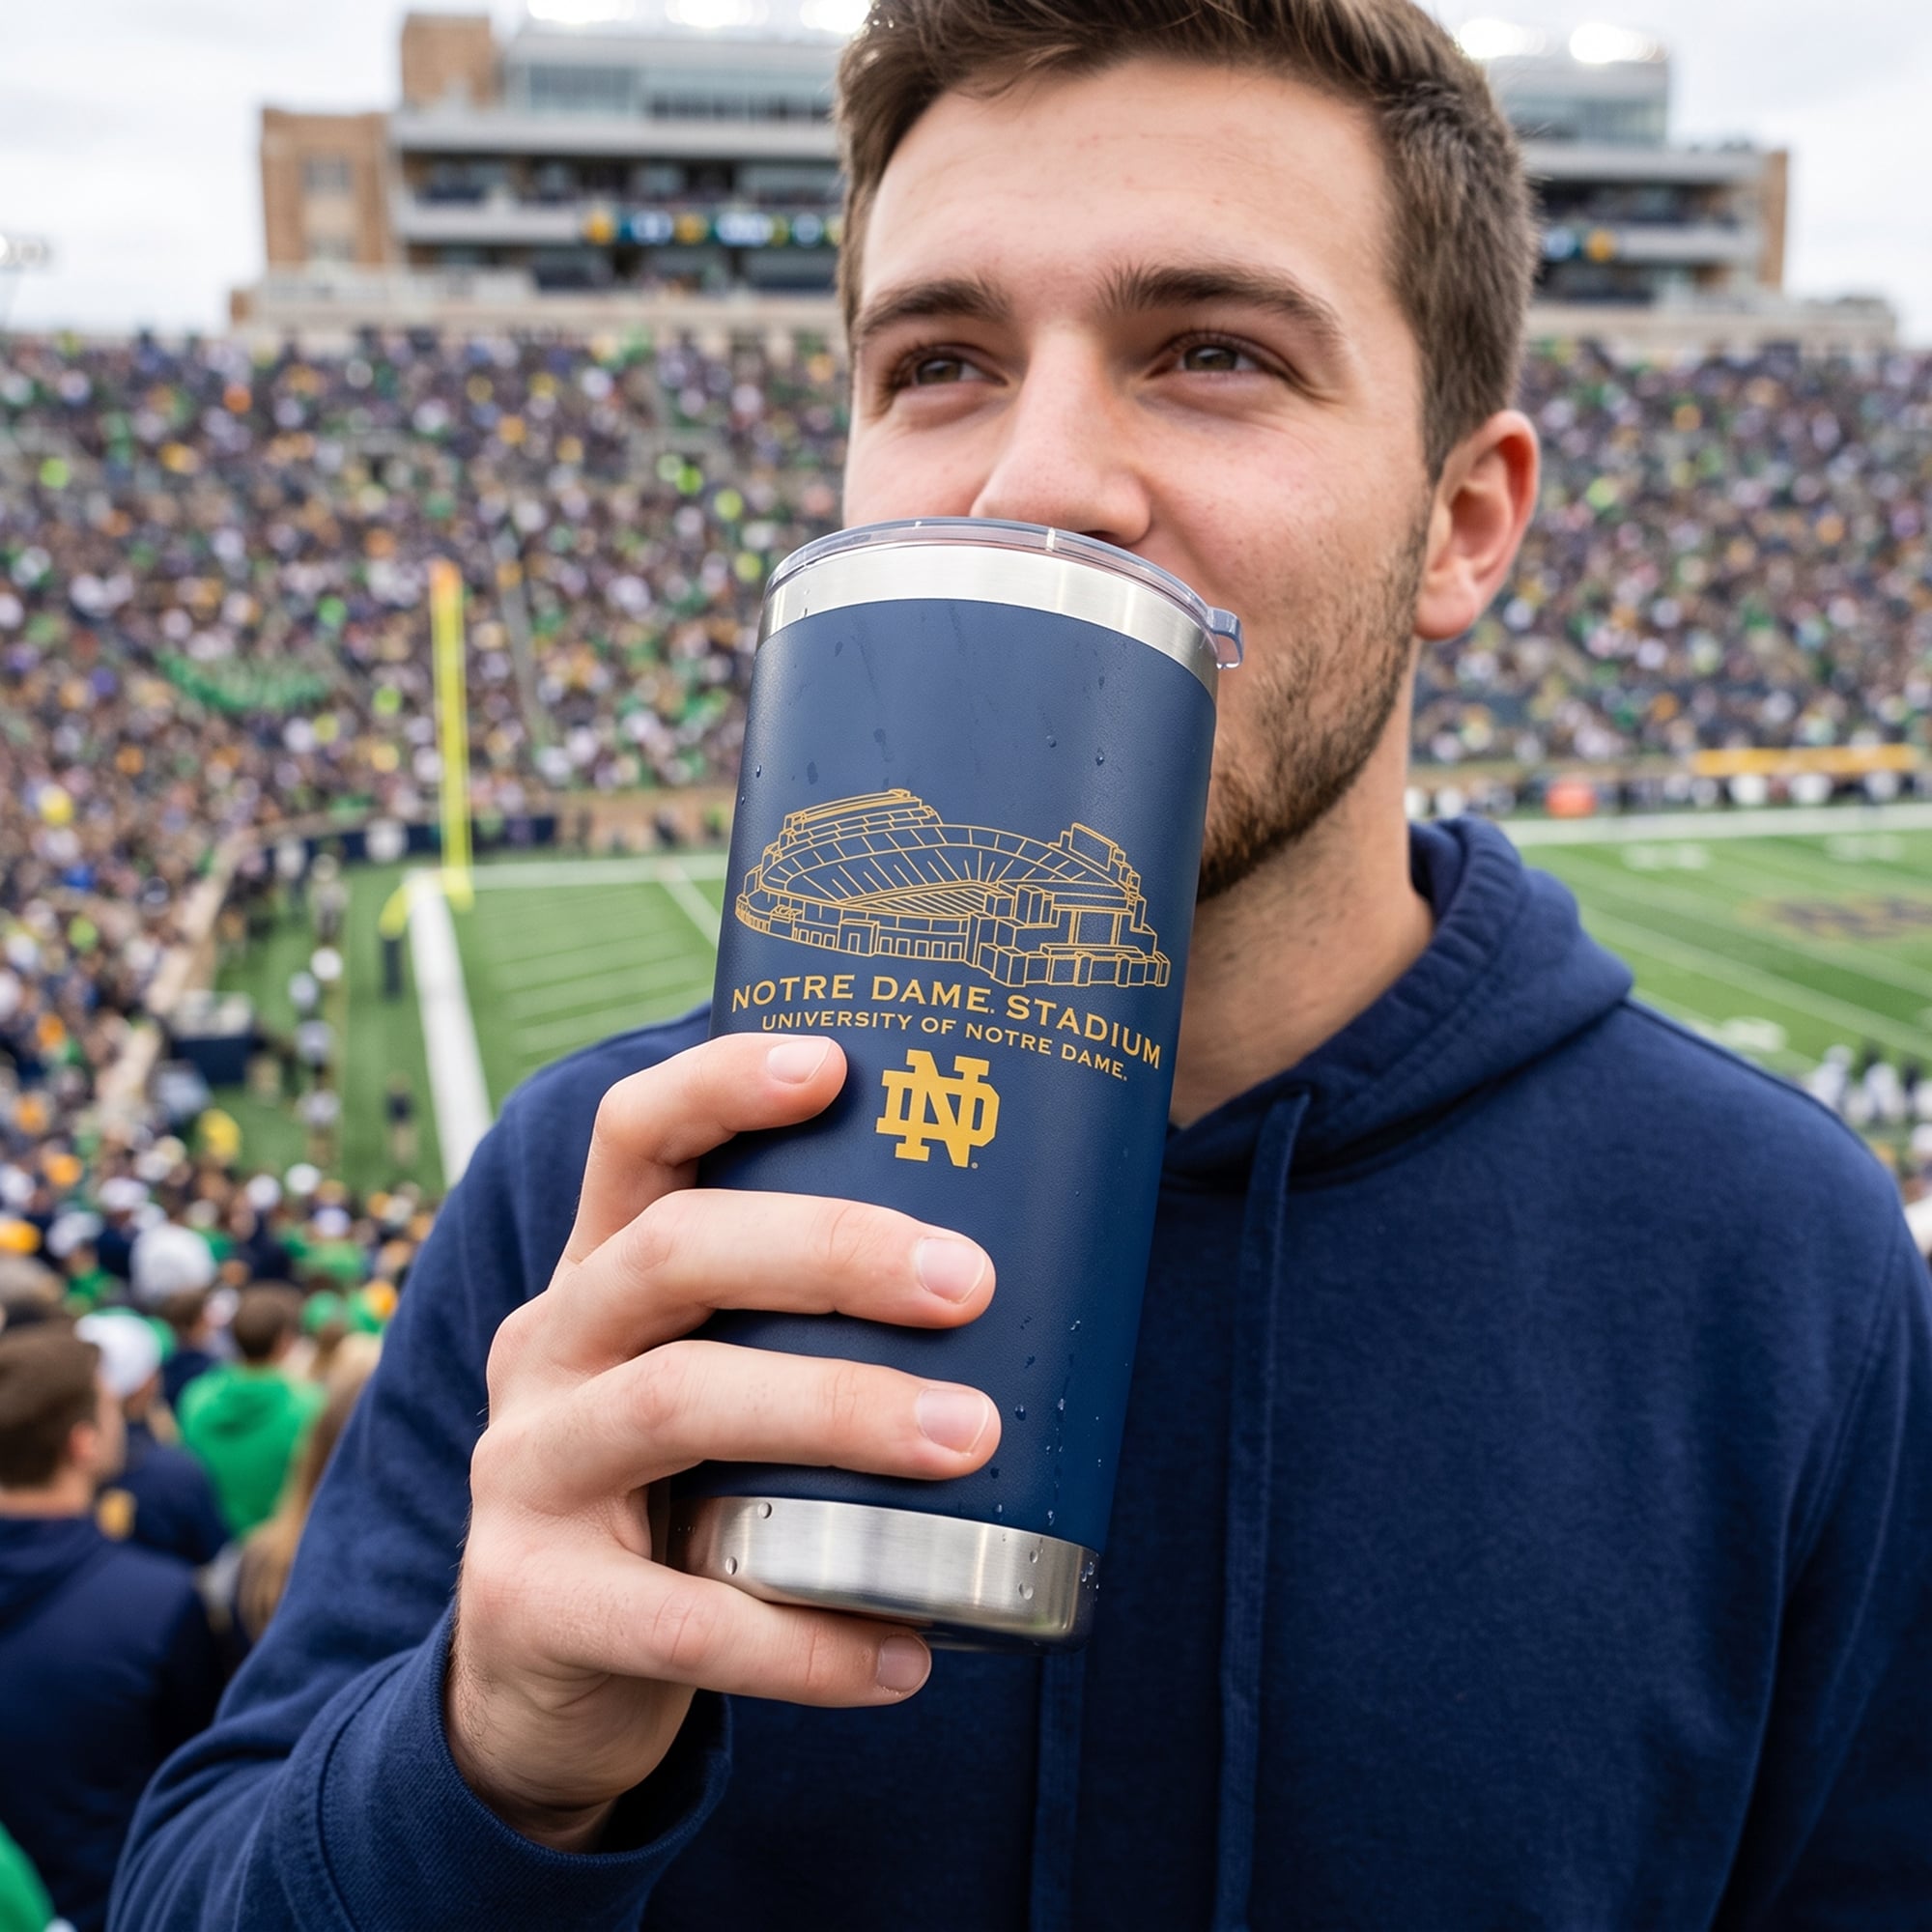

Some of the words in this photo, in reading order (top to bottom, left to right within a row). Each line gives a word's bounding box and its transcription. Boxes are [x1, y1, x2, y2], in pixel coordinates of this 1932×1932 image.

[732, 974, 856, 1012] NOTRE
[1006, 994, 1161, 1069] STADIUM
[761, 1010, 913, 1031] UNIVERSITY
[921, 1017, 956, 1035] OF
[965, 1023, 1053, 1055] NOTRE
